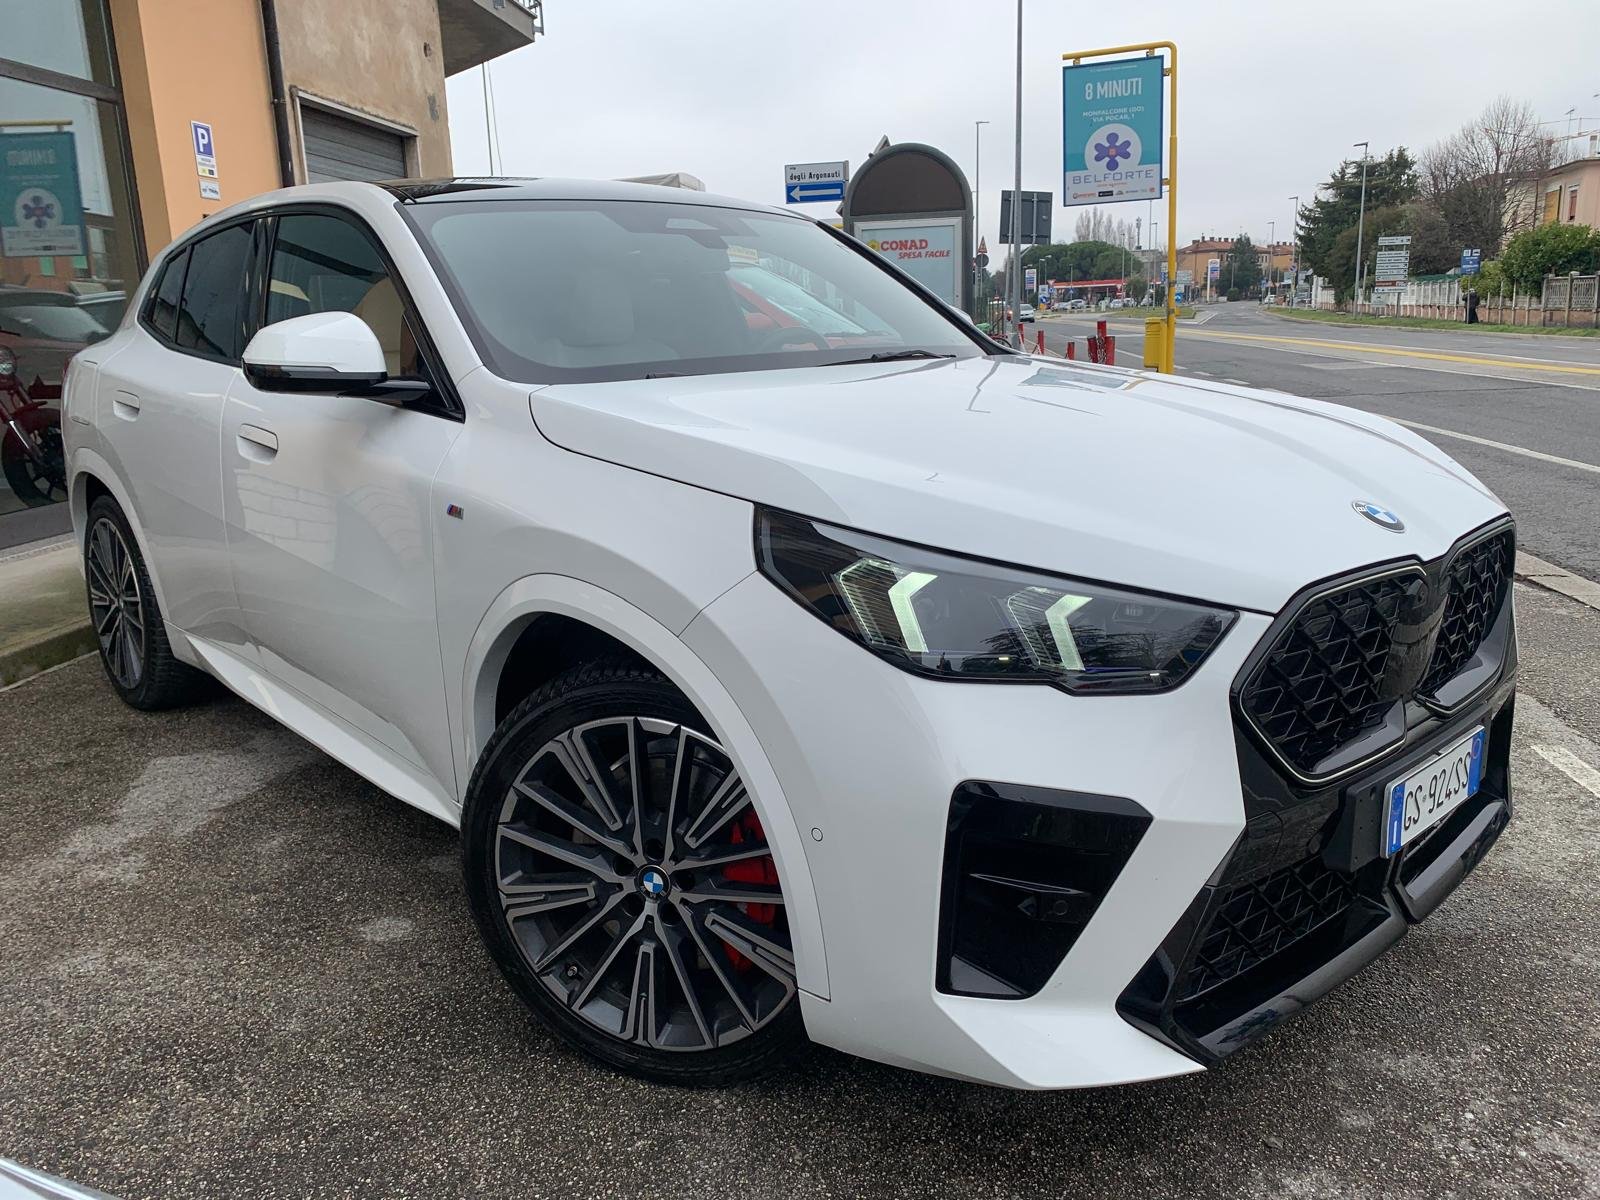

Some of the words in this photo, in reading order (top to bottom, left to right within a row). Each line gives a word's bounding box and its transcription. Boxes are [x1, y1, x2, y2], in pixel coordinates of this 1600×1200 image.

[1085, 82, 1094, 100] 8
[1096, 77, 1142, 99] MINUTI
[196, 127, 209, 152] P
[789, 172, 806, 181] degli
[808, 170, 841, 180] Argonauti
[1072, 169, 1154, 185] BELFORTE
[880, 239, 929, 252] CONAD
[898, 251, 922, 260] SPESA
[924, 249, 951, 258] FACILE
